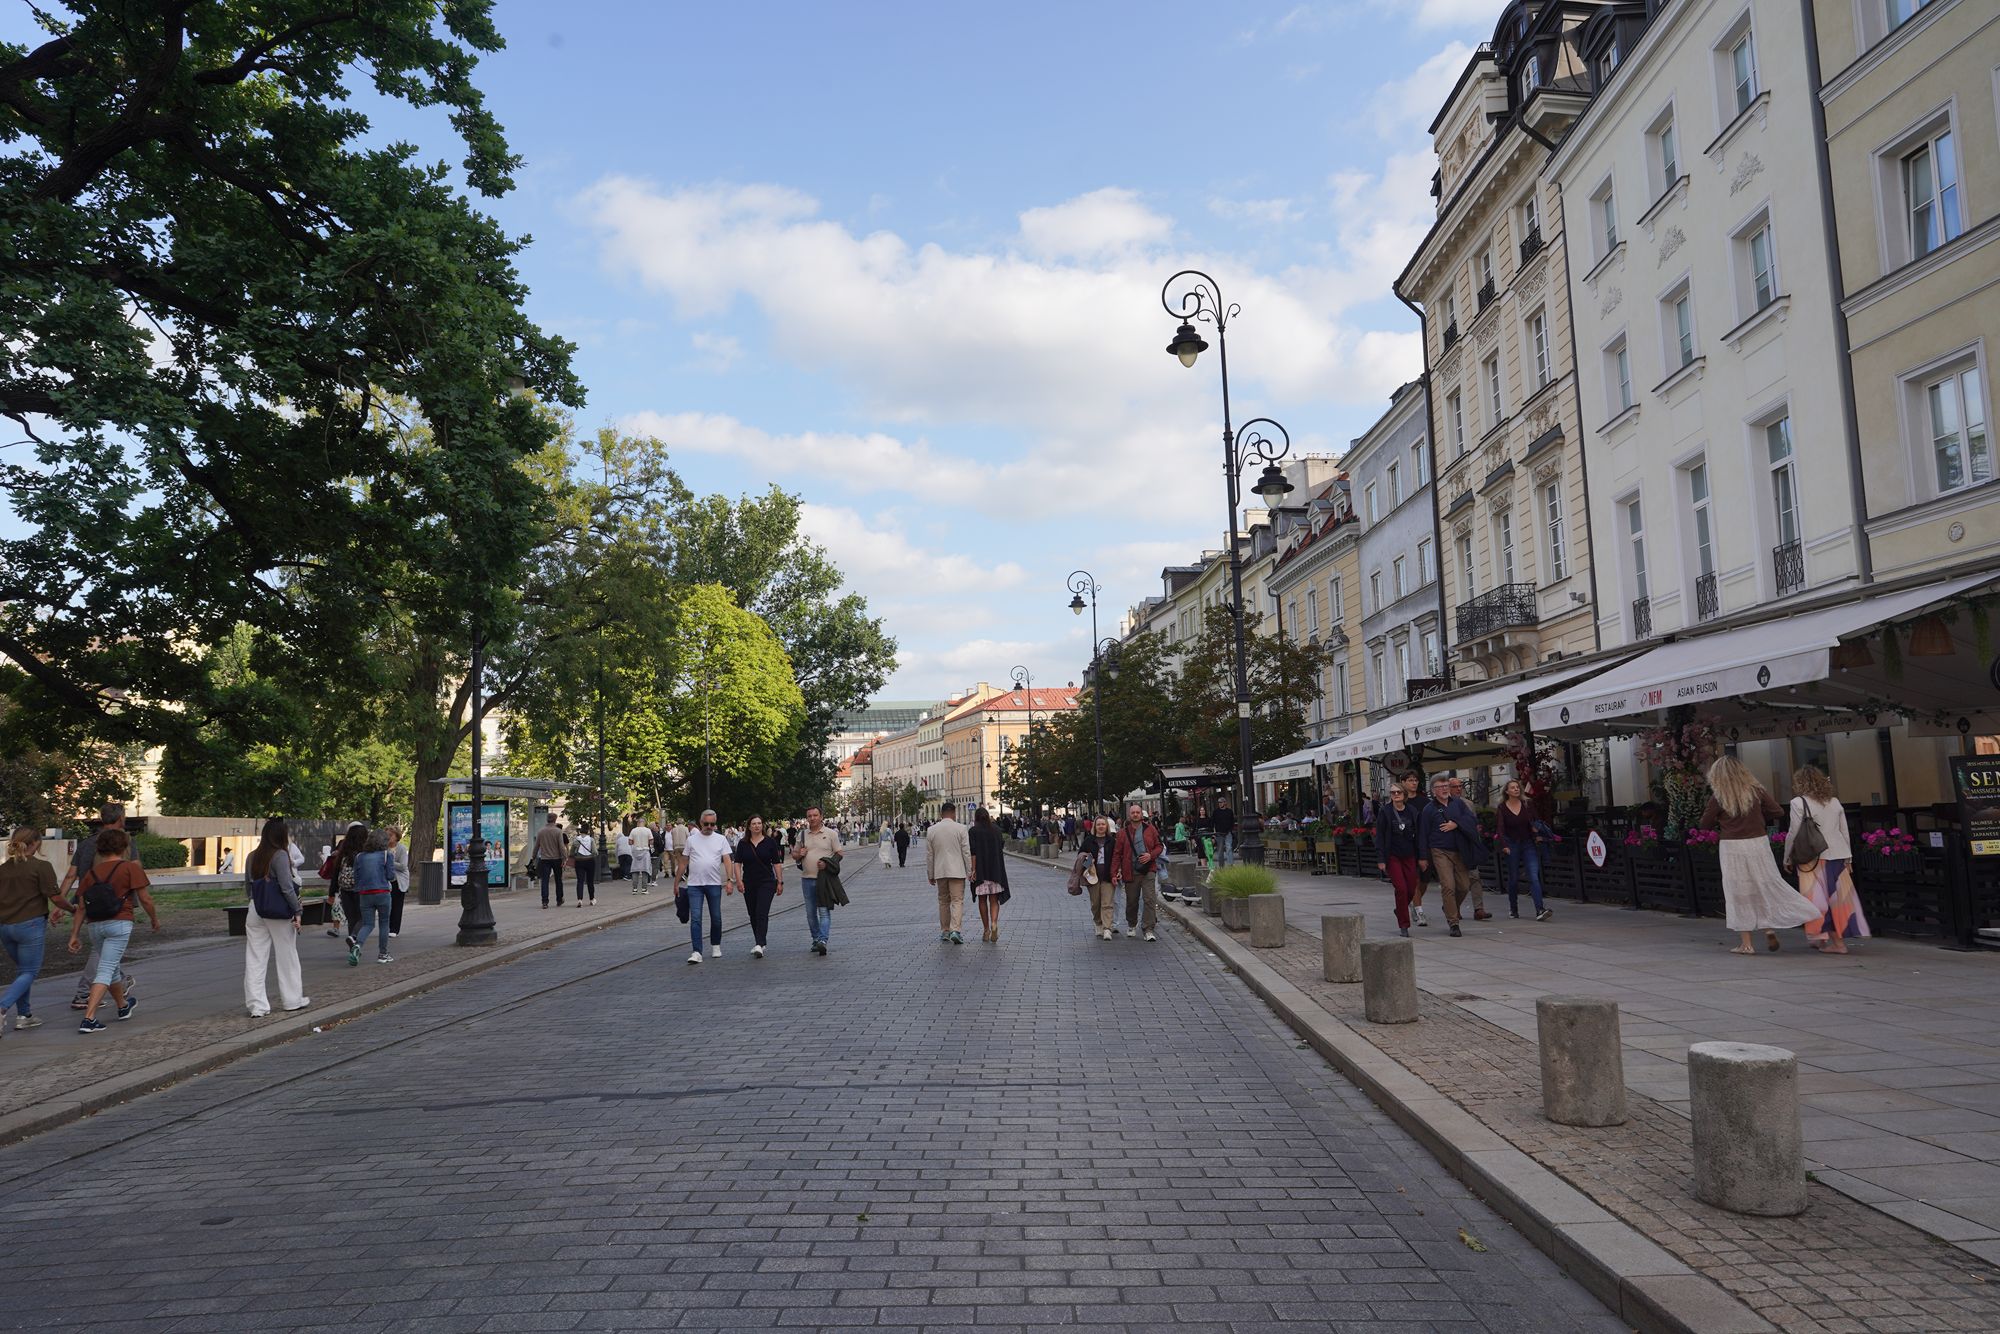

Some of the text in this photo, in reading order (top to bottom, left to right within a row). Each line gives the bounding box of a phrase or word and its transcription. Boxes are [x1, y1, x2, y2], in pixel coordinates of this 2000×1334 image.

[1422, 683, 1445, 699] Wedel
[1594, 681, 1718, 713] RESTAURANT NEM ASIAN FUSION
[1168, 779, 1197, 787] GUINNESS
